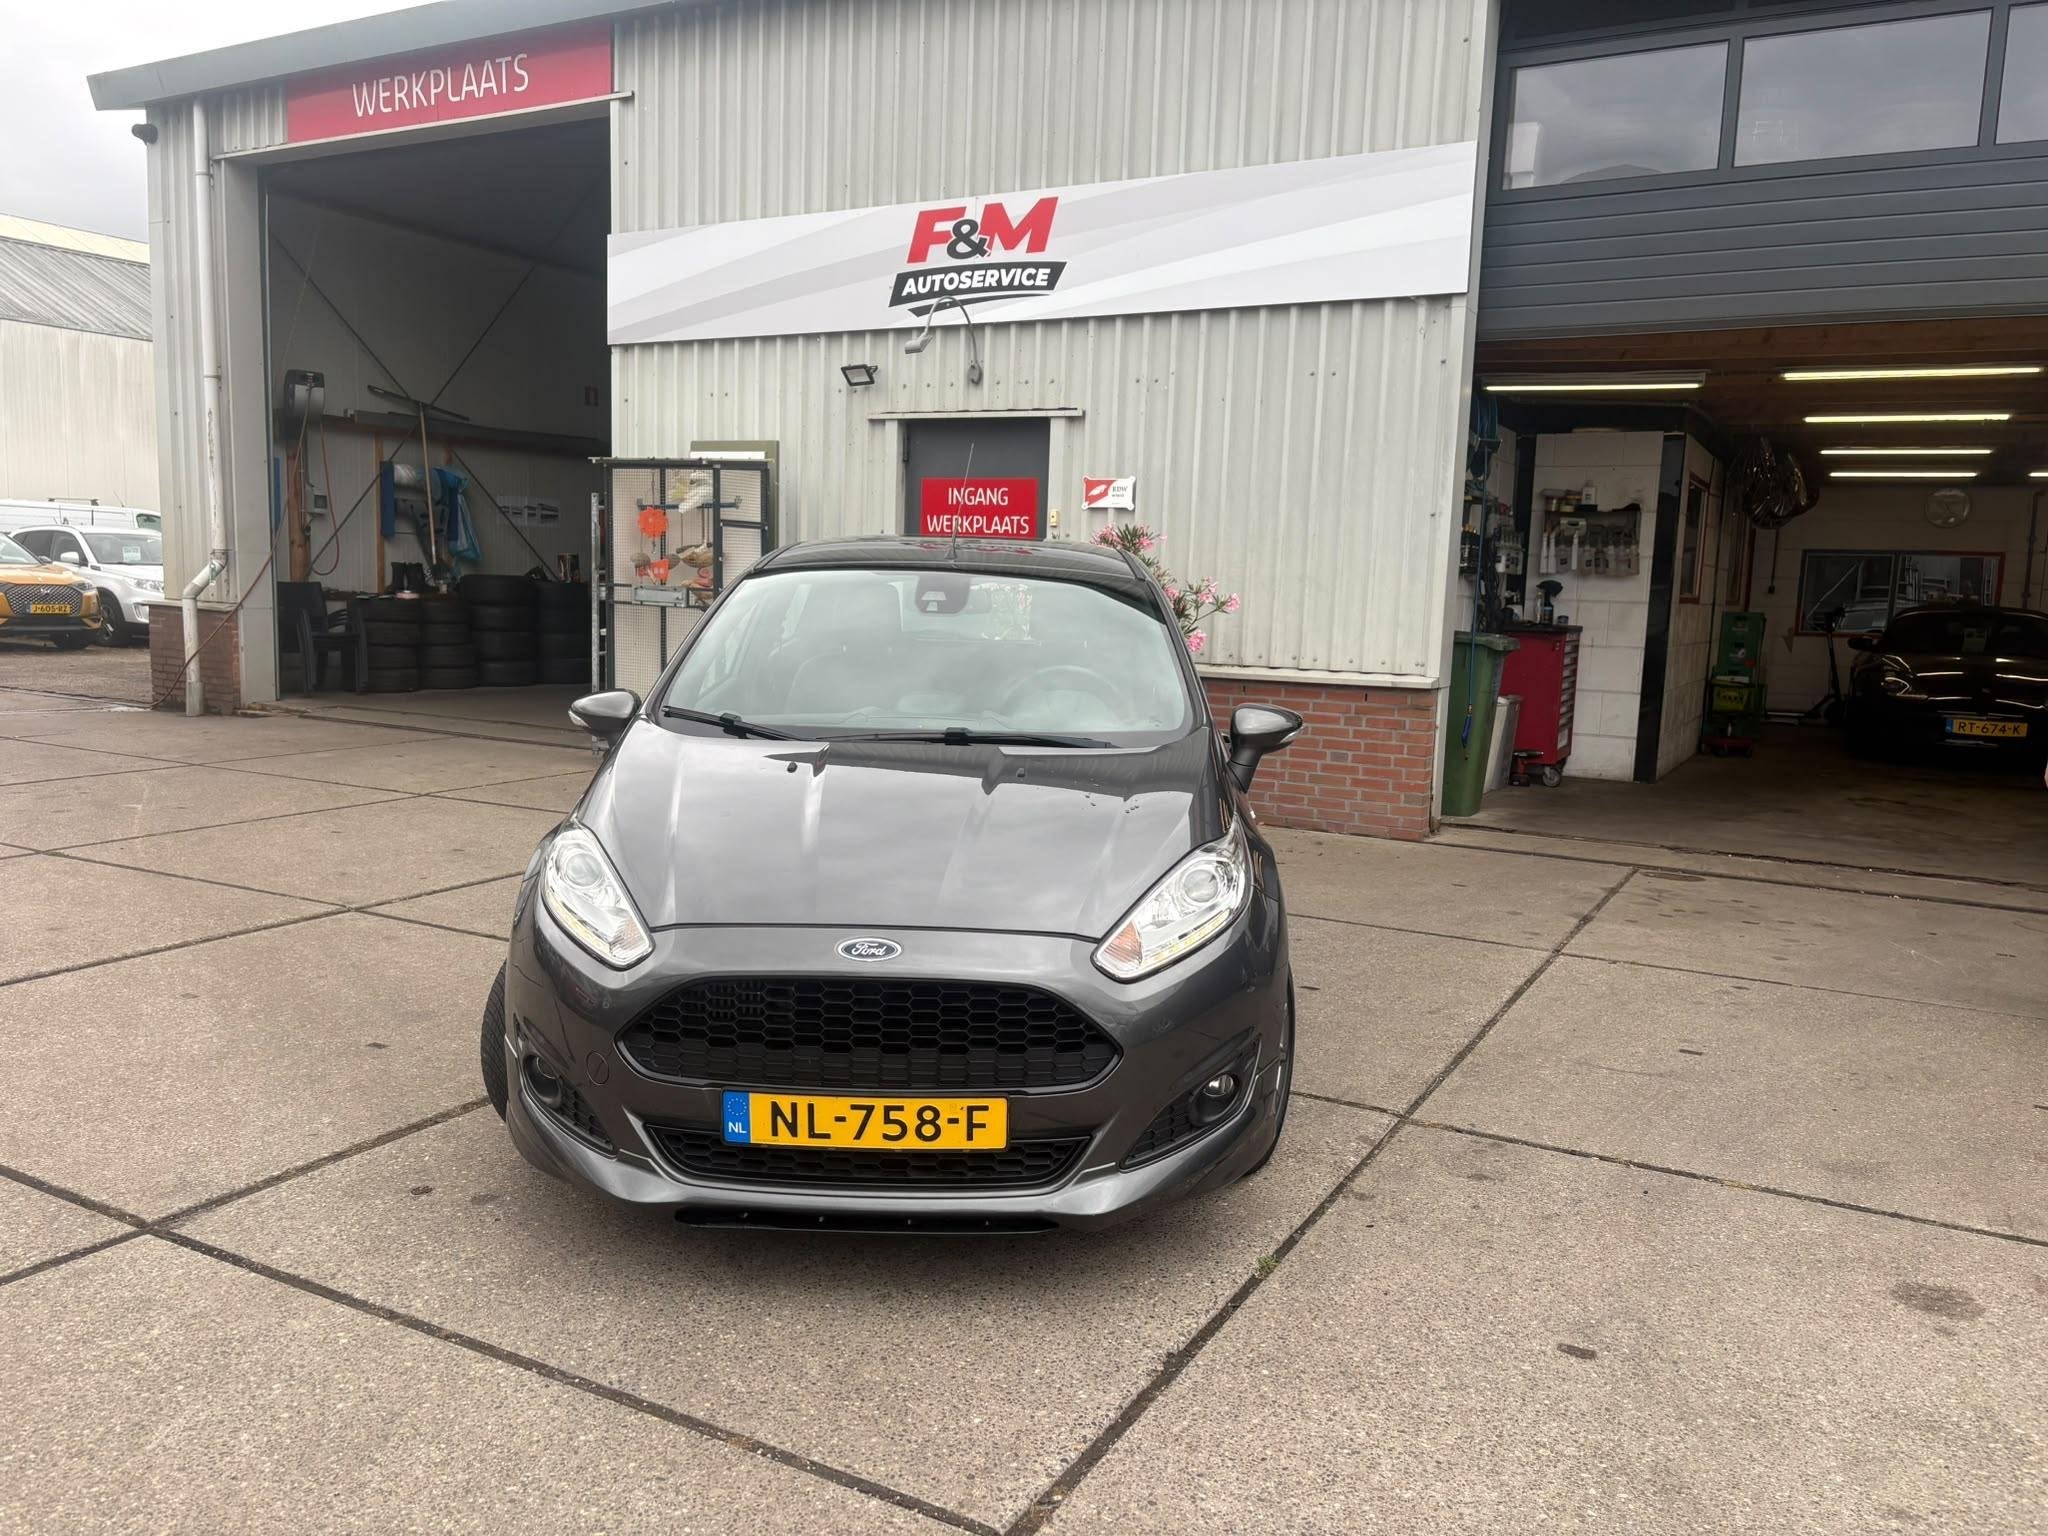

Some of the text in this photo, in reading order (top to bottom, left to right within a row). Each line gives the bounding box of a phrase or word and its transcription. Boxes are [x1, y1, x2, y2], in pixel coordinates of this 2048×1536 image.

[352, 53, 530, 118] WERKPLAATS
[906, 196, 1059, 264] F&M
[901, 268, 1051, 297] AUTOSERVICE
[948, 487, 1009, 506] INGANG
[926, 514, 1030, 534] WERKPLAATS
[1958, 721, 2021, 735] RT-674-K
[851, 942, 887, 956] Ford
[728, 1121, 747, 1134] NL
[770, 1100, 990, 1143] NL-758-F
